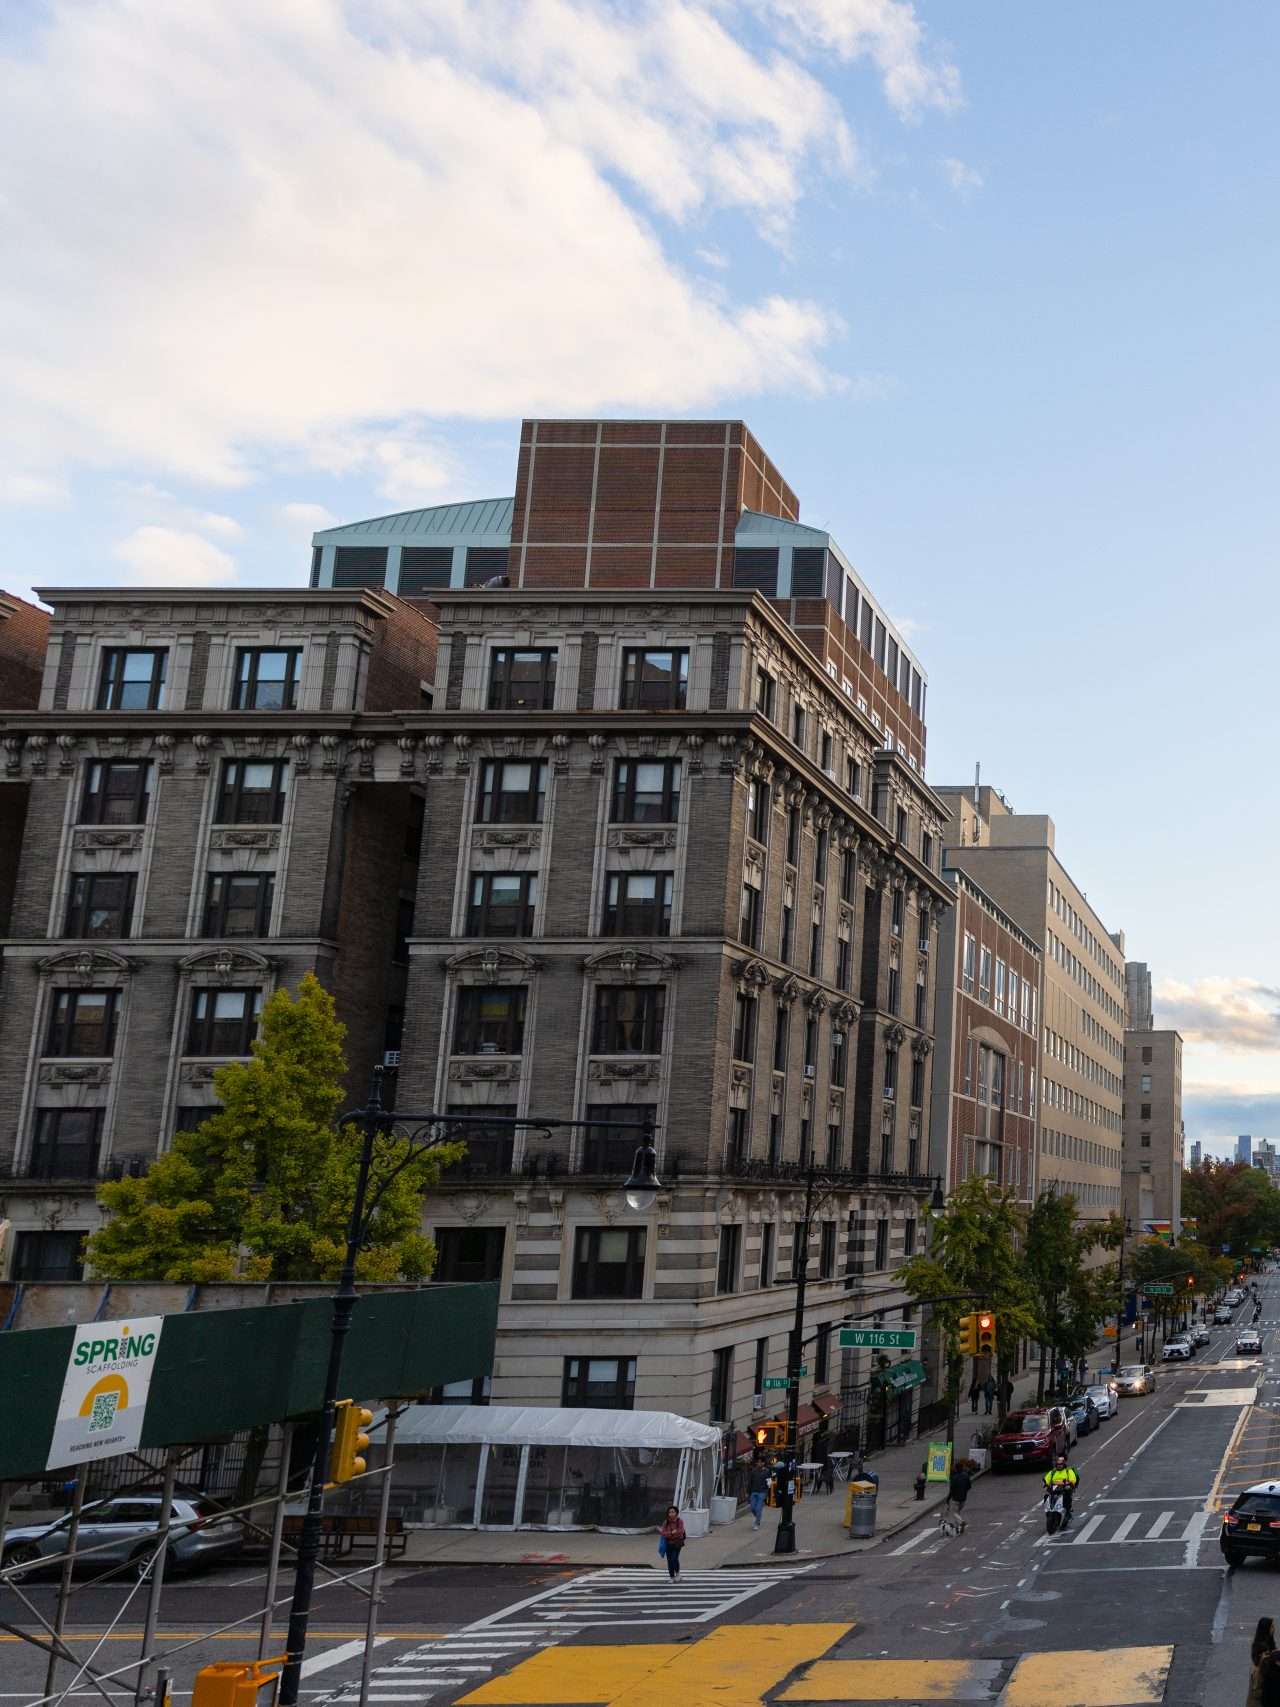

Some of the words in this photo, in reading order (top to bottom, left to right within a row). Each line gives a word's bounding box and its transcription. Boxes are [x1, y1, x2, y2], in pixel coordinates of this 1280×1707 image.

[855, 1332, 865, 1344] W
[869, 1333, 885, 1345] 116
[889, 1333, 901, 1345] St
[87, 1360, 138, 1375] SCAFFOLDING
